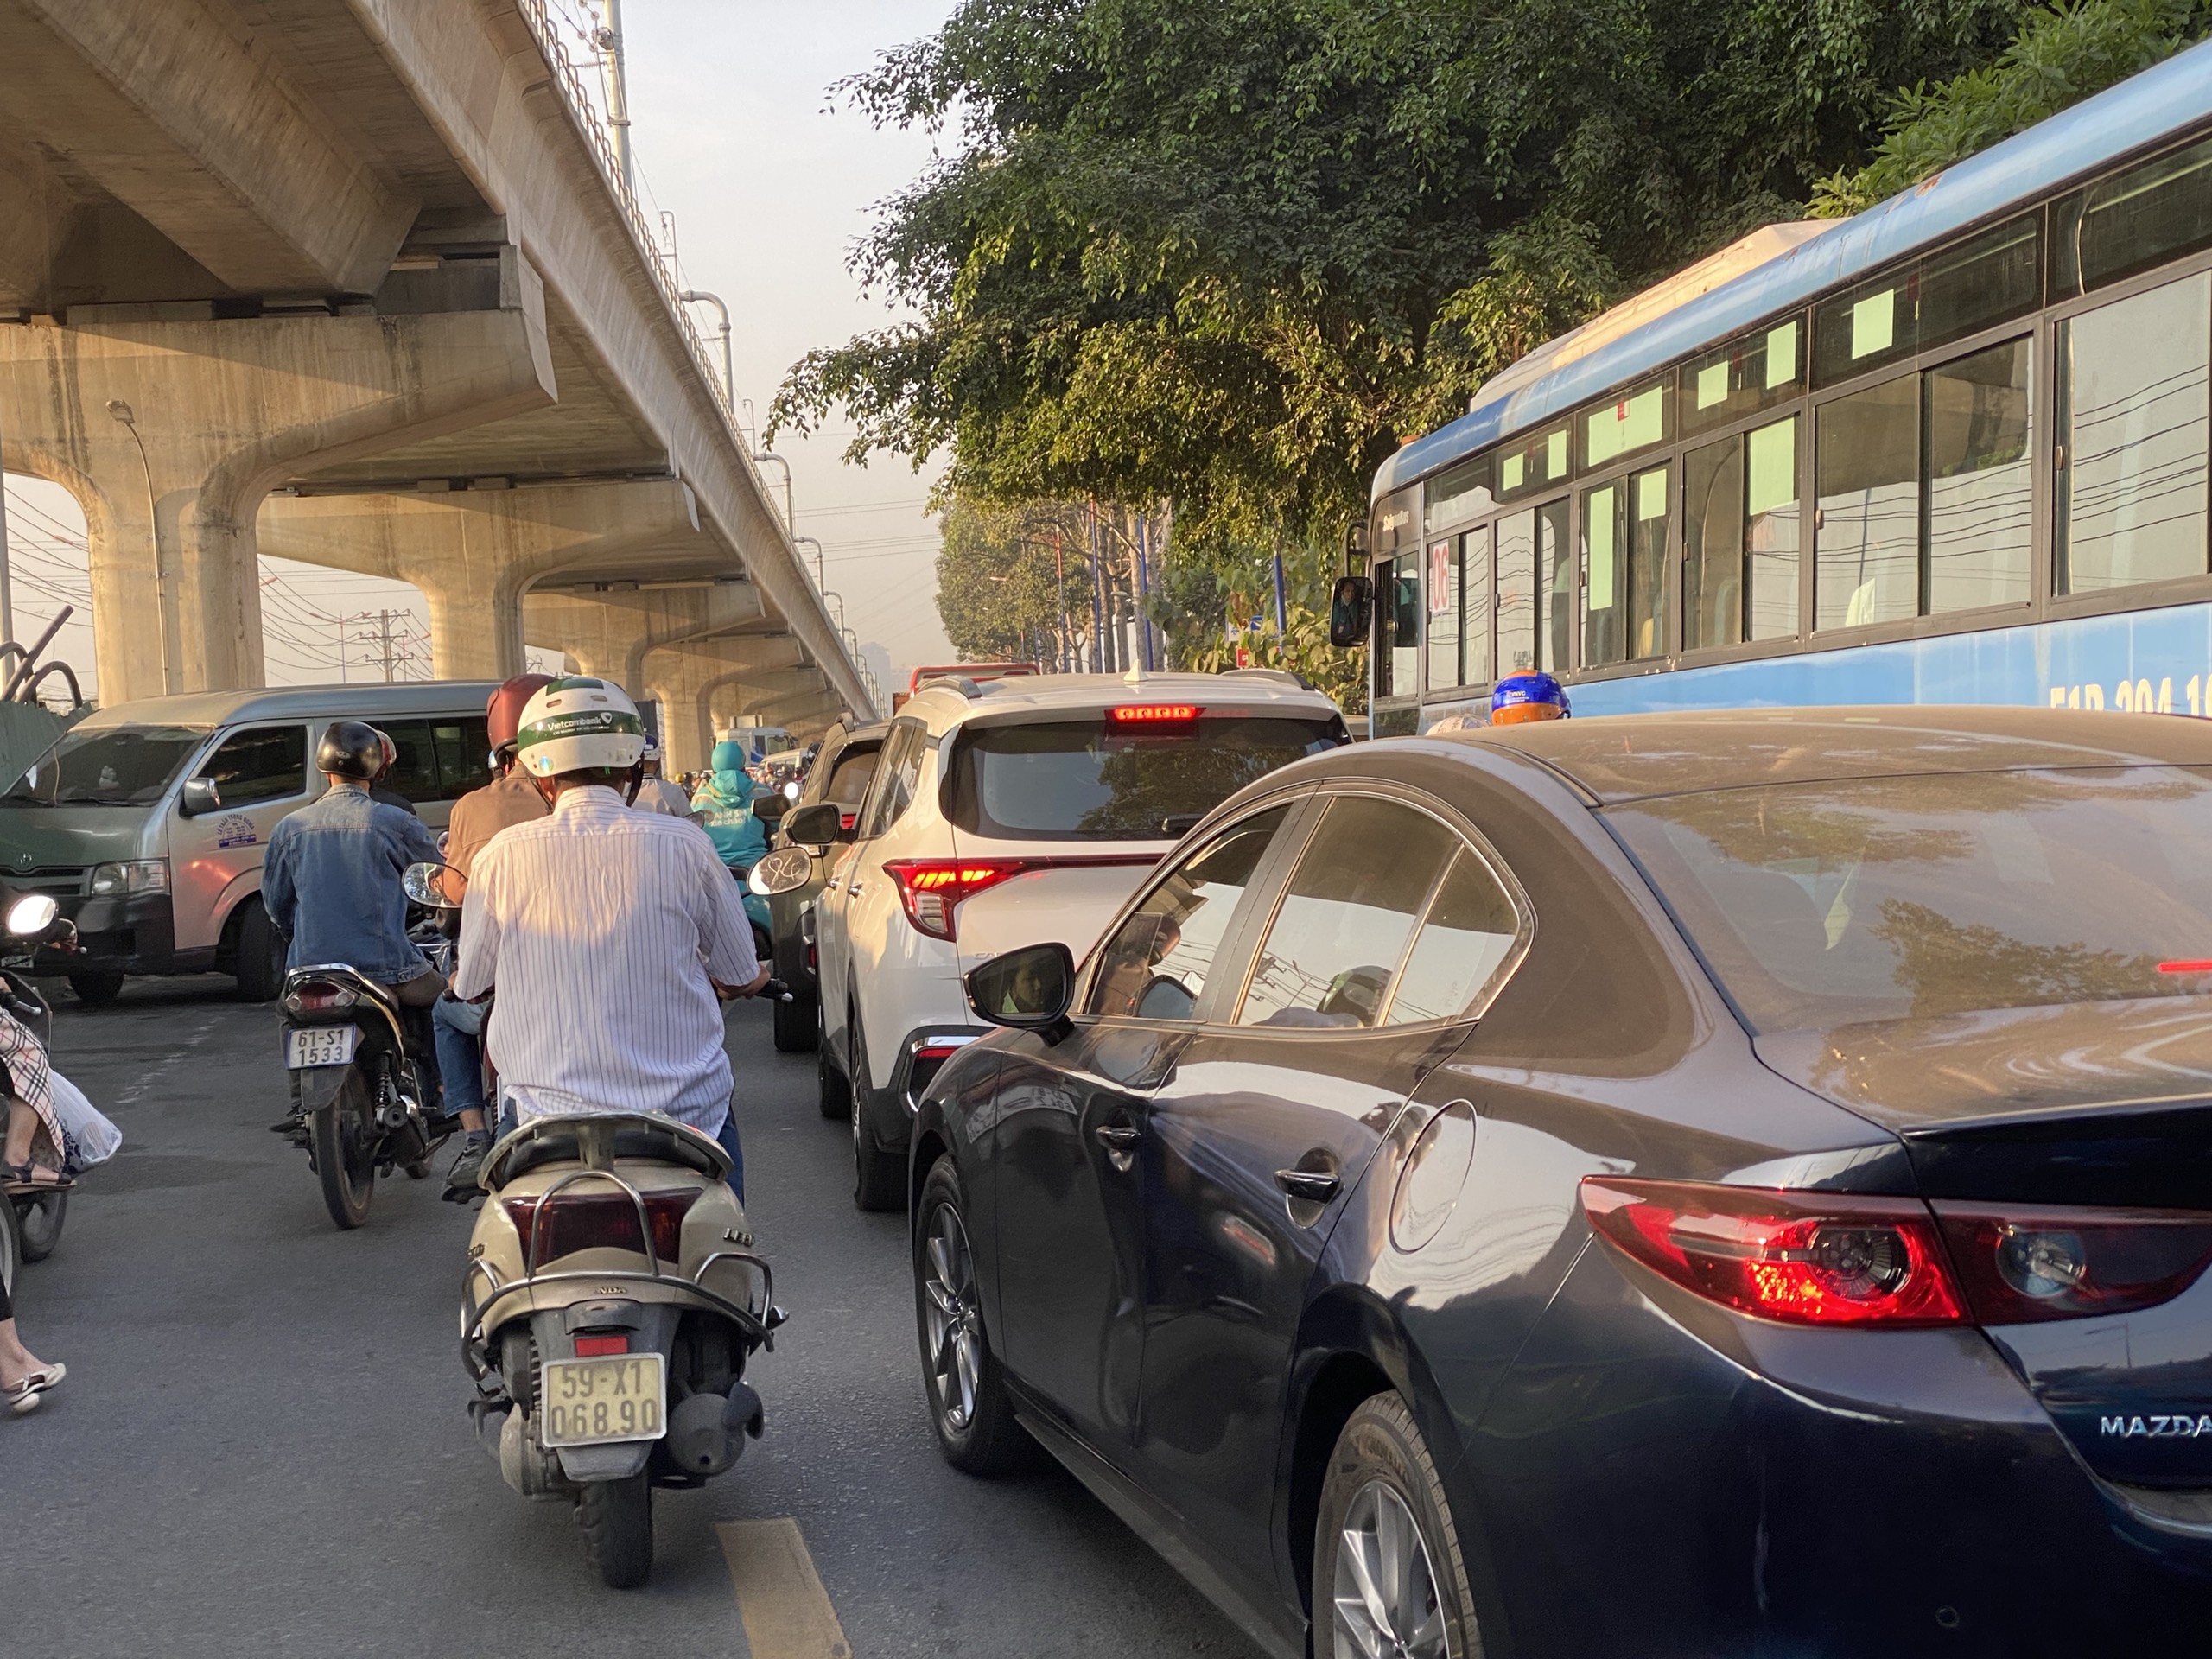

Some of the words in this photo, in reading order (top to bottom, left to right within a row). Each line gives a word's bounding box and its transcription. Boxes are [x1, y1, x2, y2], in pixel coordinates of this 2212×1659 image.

[1432, 544, 1449, 610] 06
[548, 716, 602, 731] Vietcombank
[298, 1029, 344, 1048] 61-S1
[299, 1046, 343, 1065] 1533
[562, 1361, 641, 1399] 59-X1
[551, 1398, 658, 1438] 068.90
[2101, 1414, 2212, 1438] MAZDA
